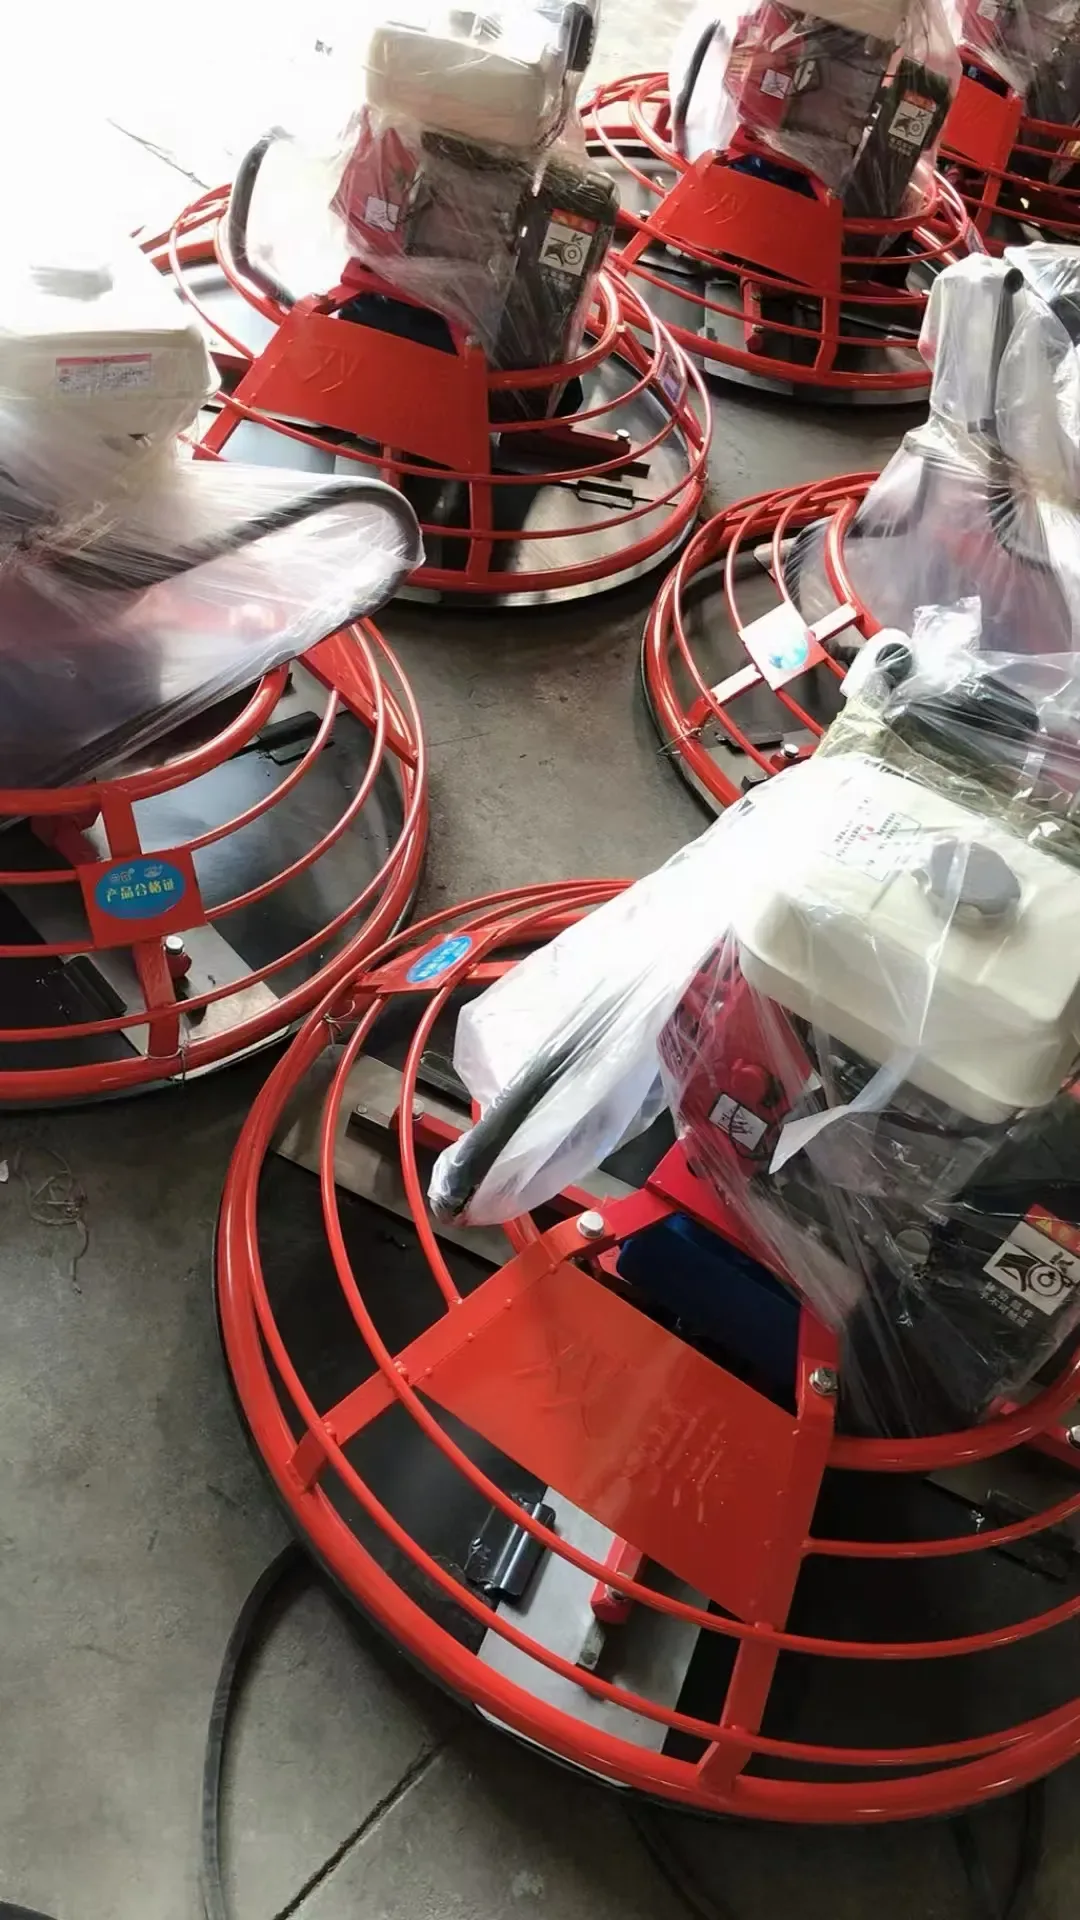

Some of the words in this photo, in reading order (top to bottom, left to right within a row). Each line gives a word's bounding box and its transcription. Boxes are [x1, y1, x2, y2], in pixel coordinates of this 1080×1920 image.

[105, 877, 175, 904] 产品合格证
